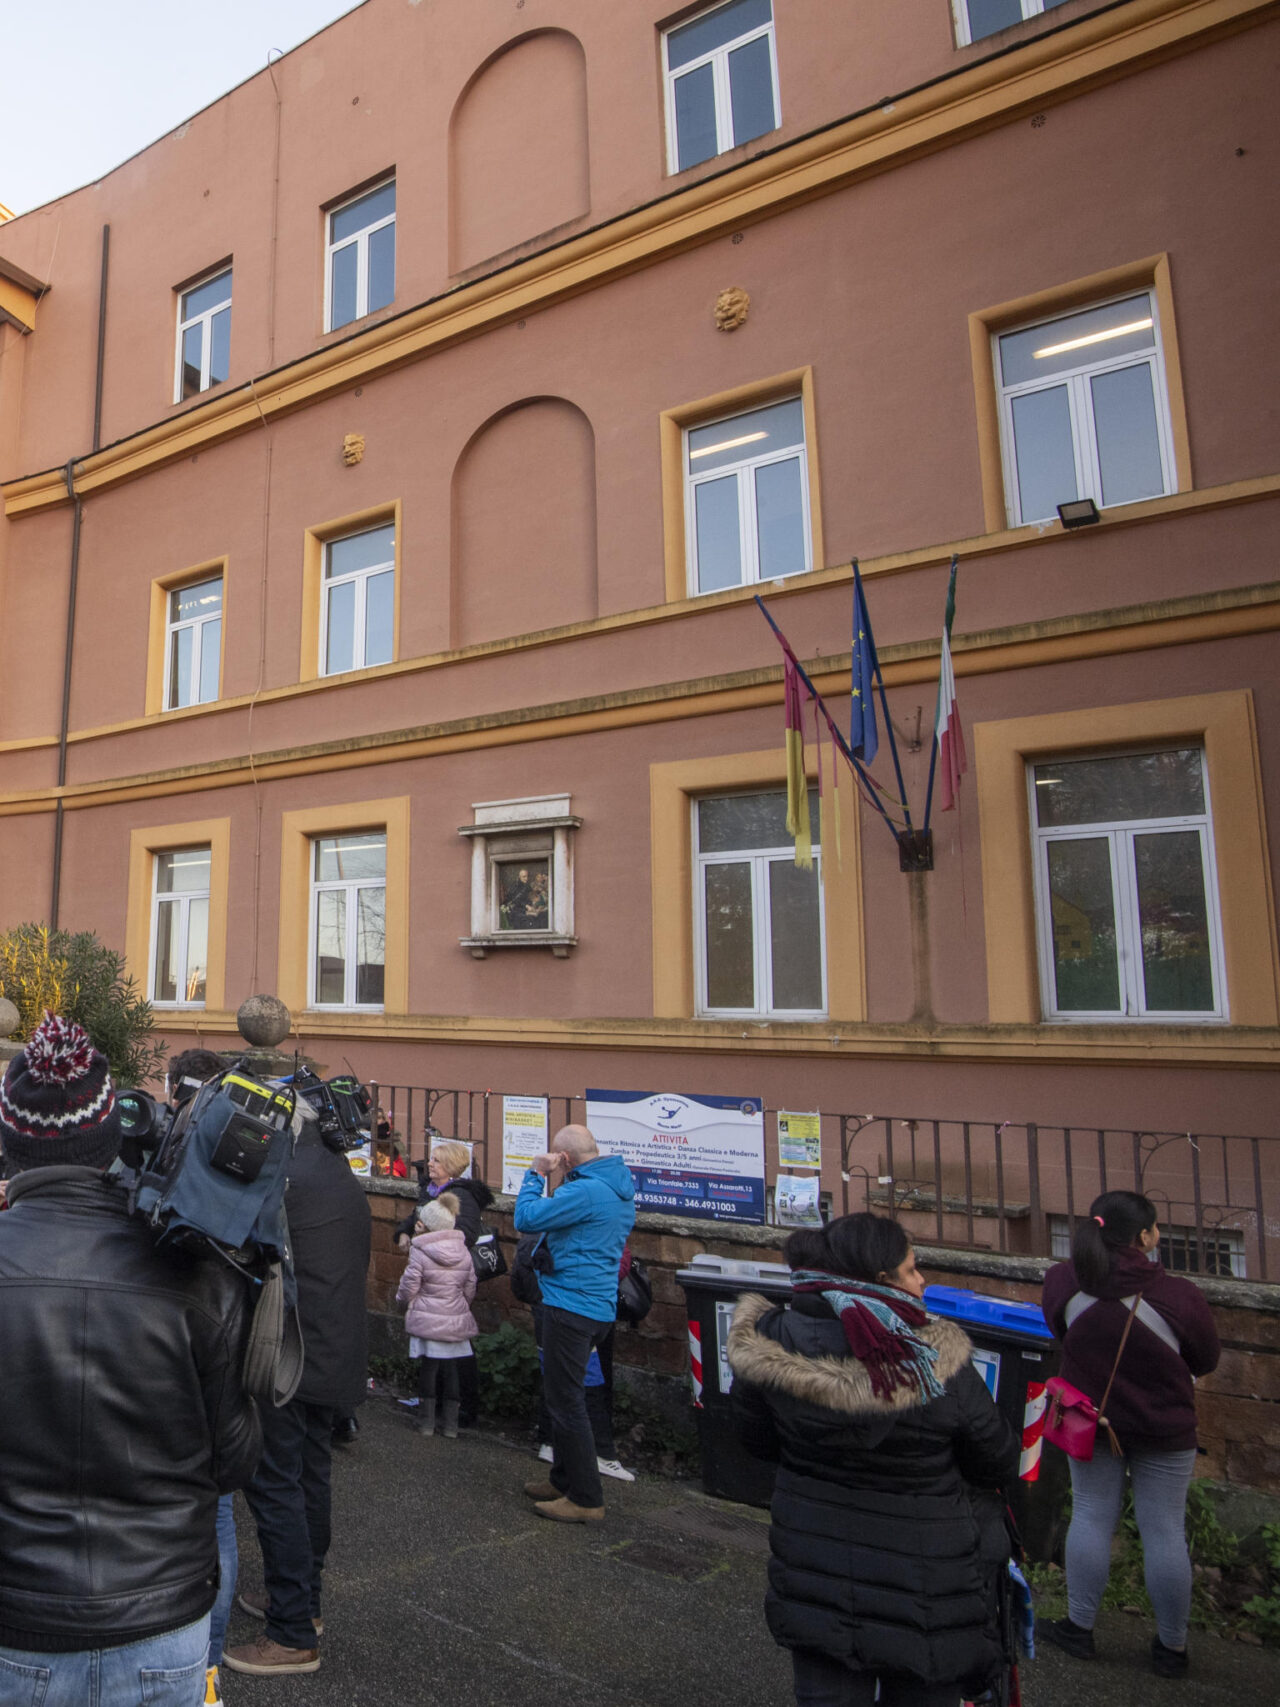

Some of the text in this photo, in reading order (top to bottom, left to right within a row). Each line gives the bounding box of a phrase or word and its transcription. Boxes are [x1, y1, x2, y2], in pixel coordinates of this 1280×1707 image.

[610, 1147, 630, 1155] Zumba
[635, 1149, 675, 1159] Propedeutica
[647, 1142, 672, 1150] Artistica
[698, 1146, 722, 1155] Classica
[729, 1149, 759, 1158] Moderna
[640, 1158, 672, 1167] Ginnastica
[673, 1161, 692, 1169] Adulti
[633, 1193, 677, 1206] 68.9353748
[684, 1198, 736, 1213] 346.4931003
